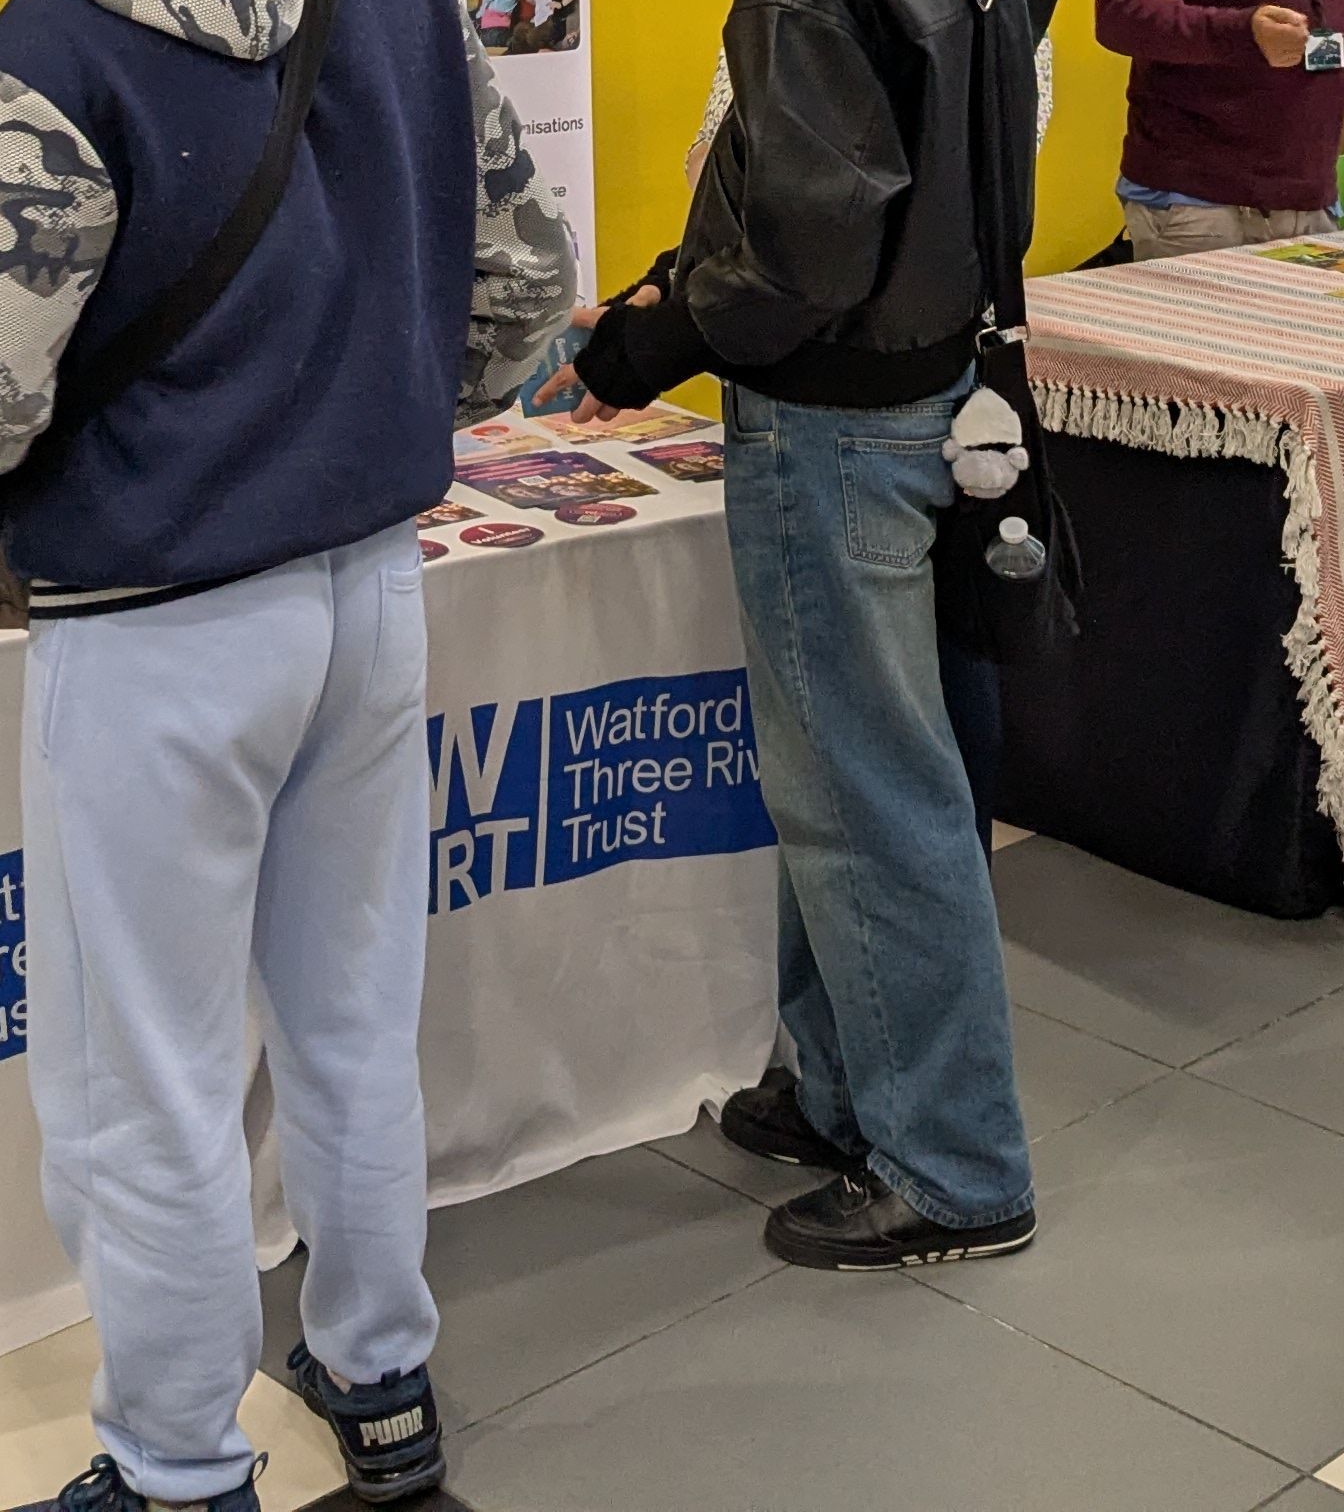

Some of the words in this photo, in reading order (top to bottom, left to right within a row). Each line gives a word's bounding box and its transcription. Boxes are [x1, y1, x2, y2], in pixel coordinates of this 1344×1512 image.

[521, 118, 584, 135] nisations
[566, 685, 742, 756] Watford
[563, 757, 692, 810] Three
[706, 740, 760, 789] Riv
[562, 801, 666, 863] Trust
[435, 817, 529, 914] RT
[359, 1405, 423, 1447] PUMA
